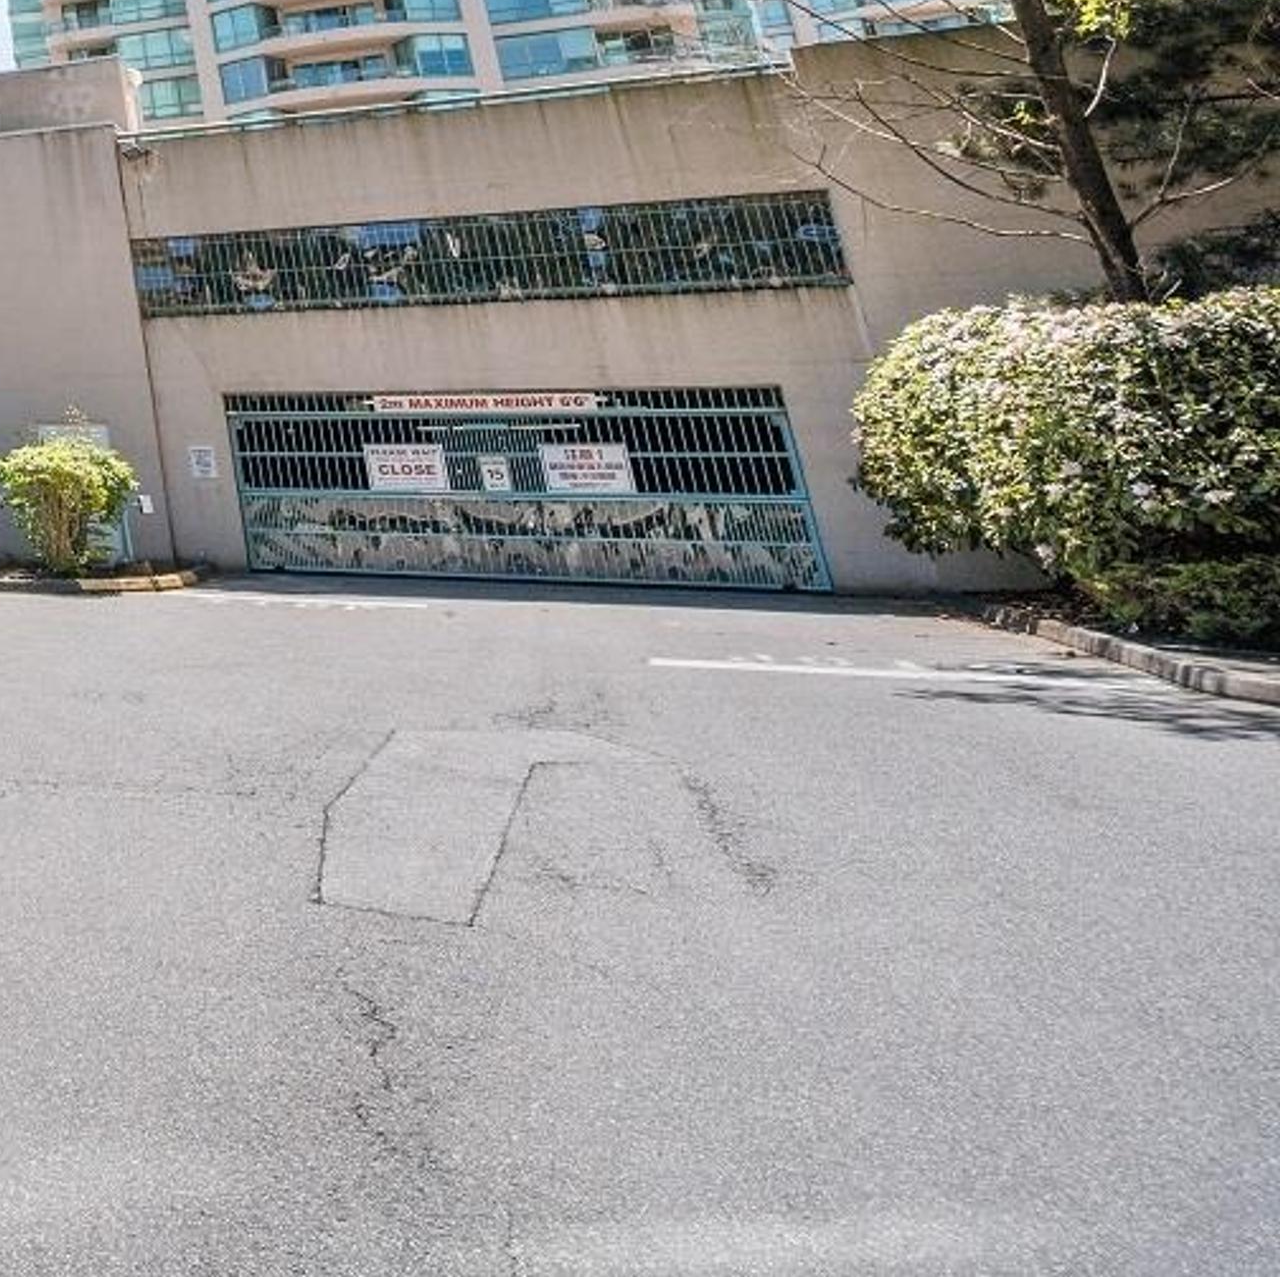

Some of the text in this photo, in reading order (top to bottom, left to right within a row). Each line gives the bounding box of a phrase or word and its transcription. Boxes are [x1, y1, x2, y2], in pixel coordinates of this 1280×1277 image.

[408, 397, 489, 410] MAXIMUM
[492, 395, 554, 409] HEIGHT
[378, 464, 438, 476] CLOSE
[487, 467, 505, 481] 15
